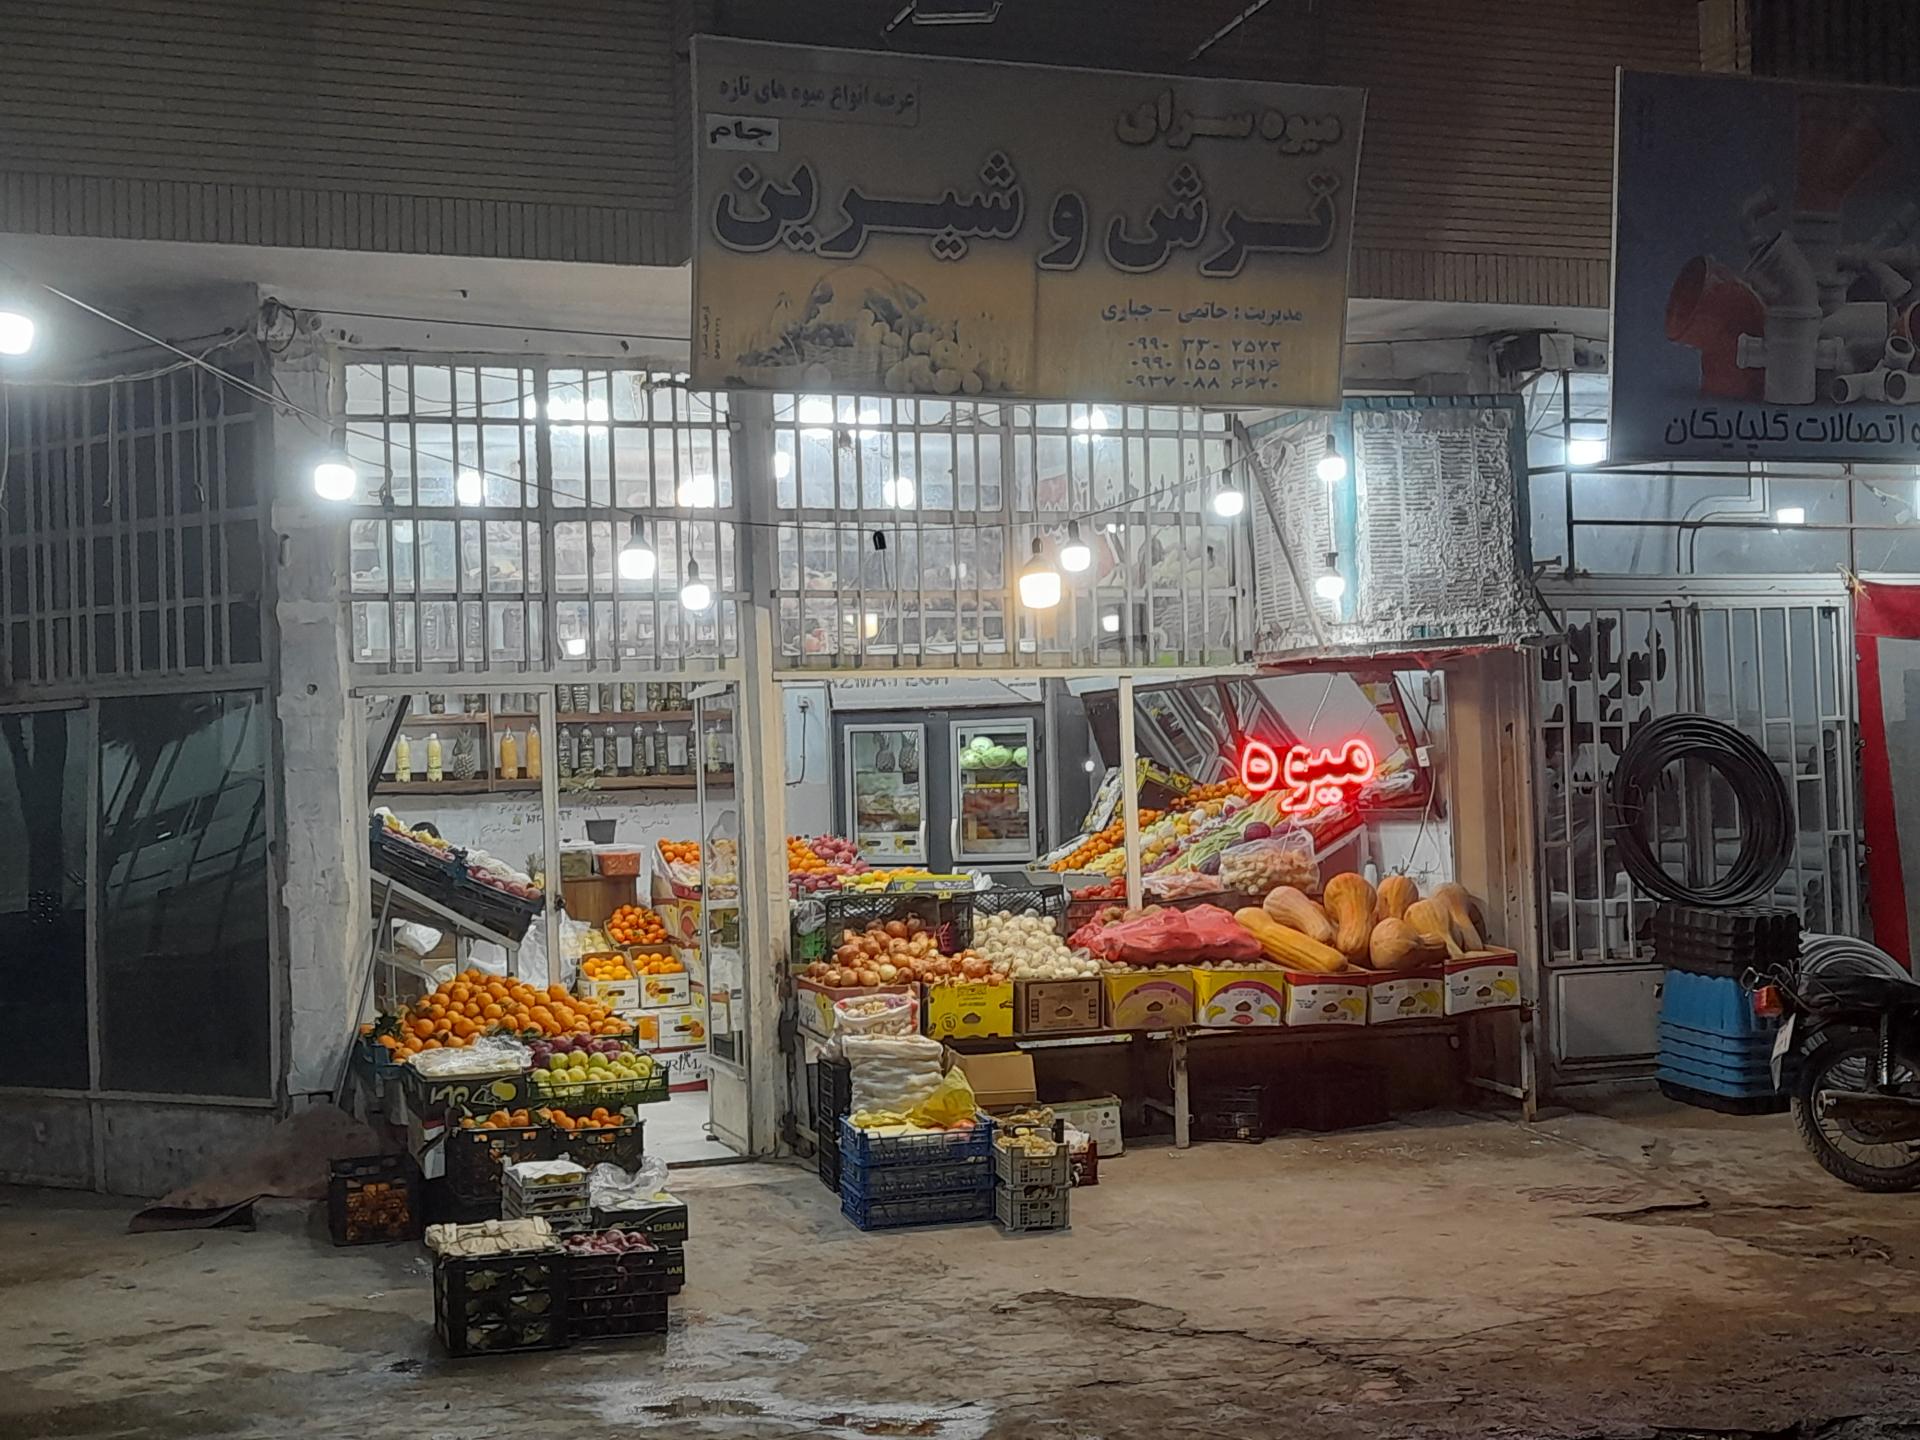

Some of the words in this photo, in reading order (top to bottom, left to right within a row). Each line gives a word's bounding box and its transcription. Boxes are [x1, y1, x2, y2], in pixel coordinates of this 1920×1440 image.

[719, 75, 751, 103] تازه
[754, 78, 787, 105] های
[791, 86, 825, 109] میوه
[829, 84, 869, 112] انواع
[1113, 87, 1257, 150] سرای
[1260, 107, 1340, 155] میوه
[709, 120, 771, 146] جام
[711, 150, 1024, 262] شیرین
[1102, 162, 1337, 278] ترش
[1036, 189, 1088, 272] و
[1101, 298, 1152, 322] جباری
[1176, 301, 1226, 322] حاتمی
[1186, 357, 1221, 370] ۱۵۵
[1796, 411, 1905, 444] اتصالات
[1241, 739, 1375, 813] میوه
